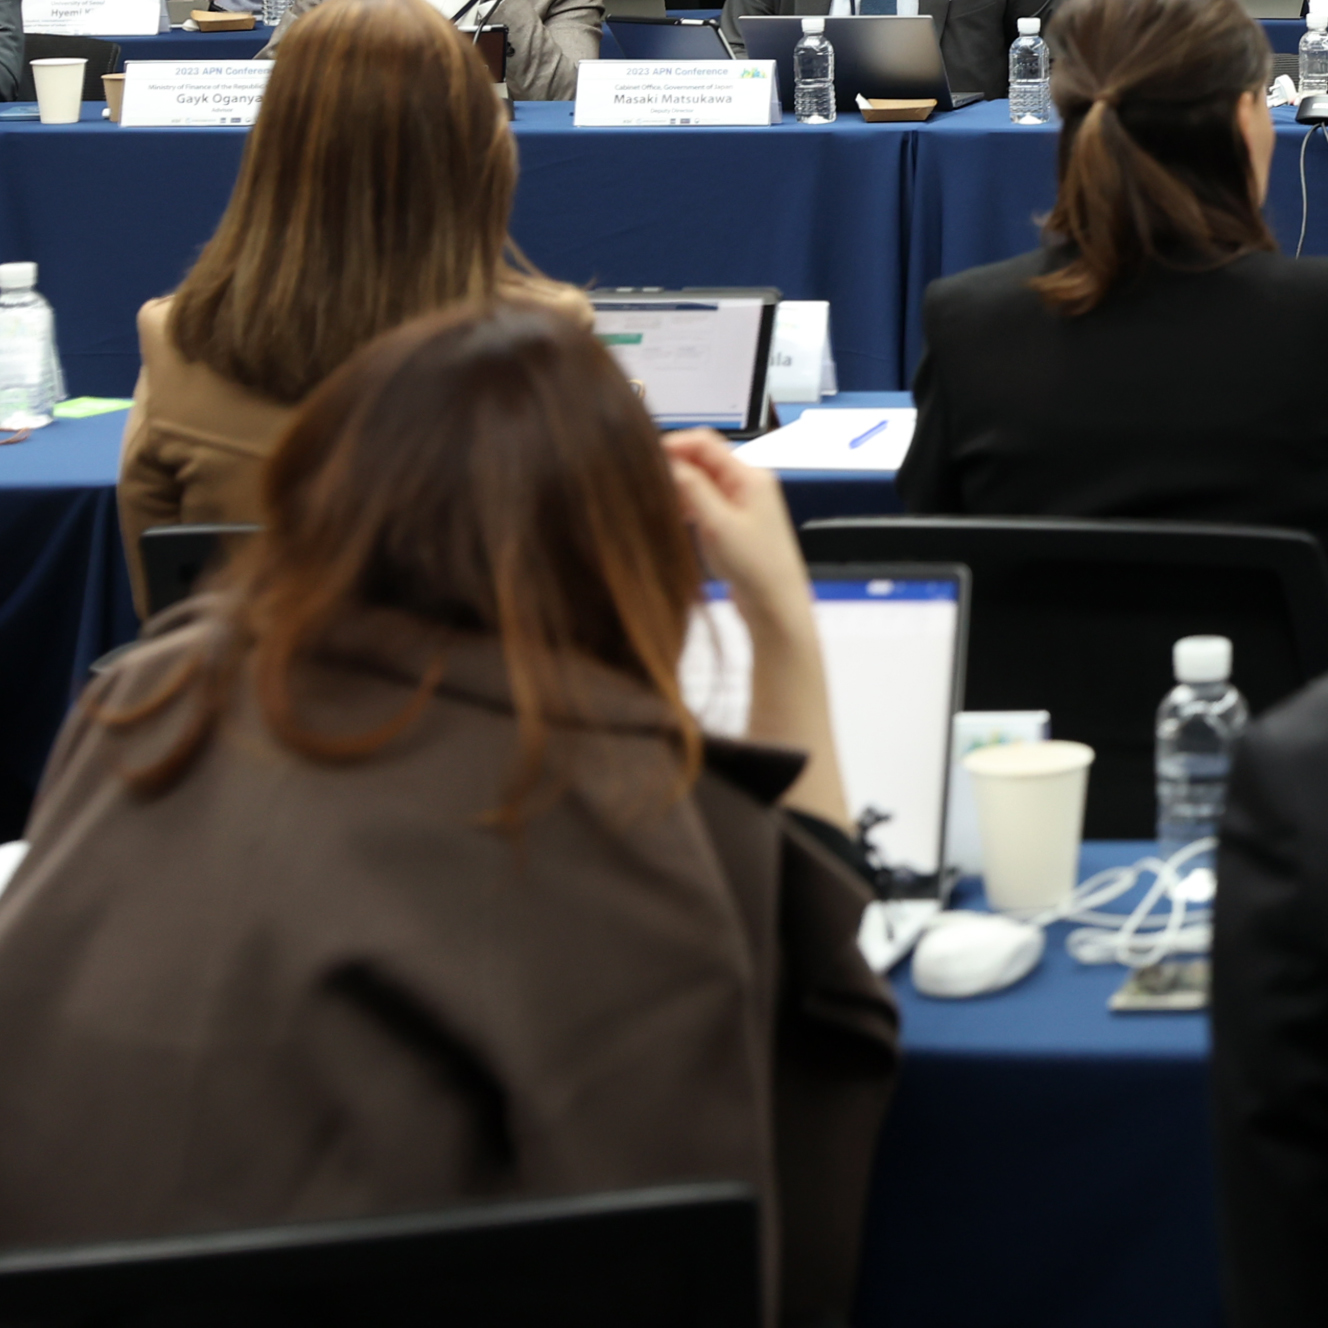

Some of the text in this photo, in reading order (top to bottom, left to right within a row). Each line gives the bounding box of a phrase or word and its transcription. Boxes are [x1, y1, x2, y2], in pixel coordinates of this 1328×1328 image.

[51, 8, 82, 18] Hyemi
[175, 67, 270, 75] 2023 APN Conferen
[626, 67, 728, 76] 2023 APN Conference
[148, 84, 176, 92] Ministry
[176, 93, 263, 106] Gayk Oganya
[614, 94, 732, 104] Masaki Matsukawa
